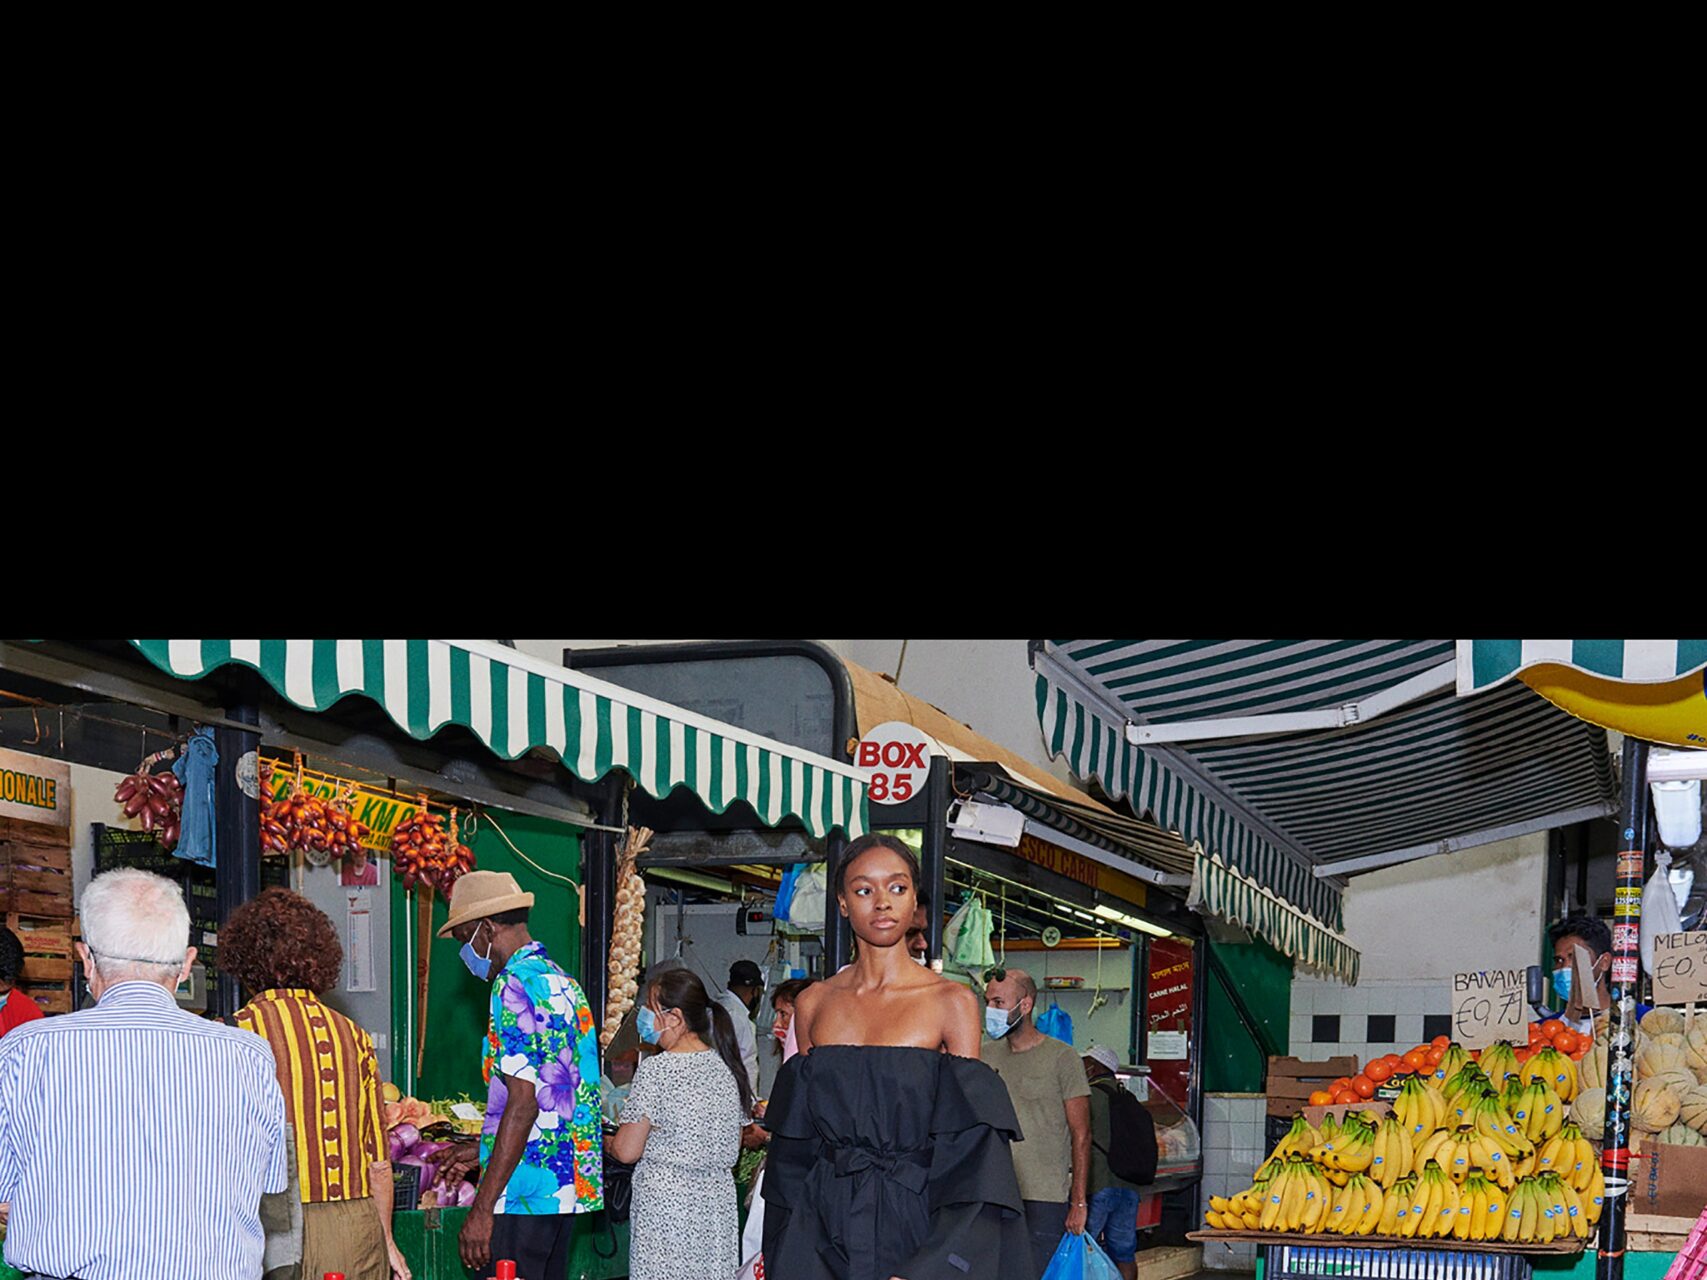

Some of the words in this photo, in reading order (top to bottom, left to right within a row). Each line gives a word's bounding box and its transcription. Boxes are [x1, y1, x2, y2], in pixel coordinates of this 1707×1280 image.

[858, 741, 927, 769] BOX
[868, 772, 912, 801] 85
[360, 797, 398, 833] KM
[1060, 853, 1099, 887] CARNI
[1654, 933, 1707, 952] MELO
[1149, 988, 1168, 1000] CARNE
[1169, 983, 1188, 994] HALAL
